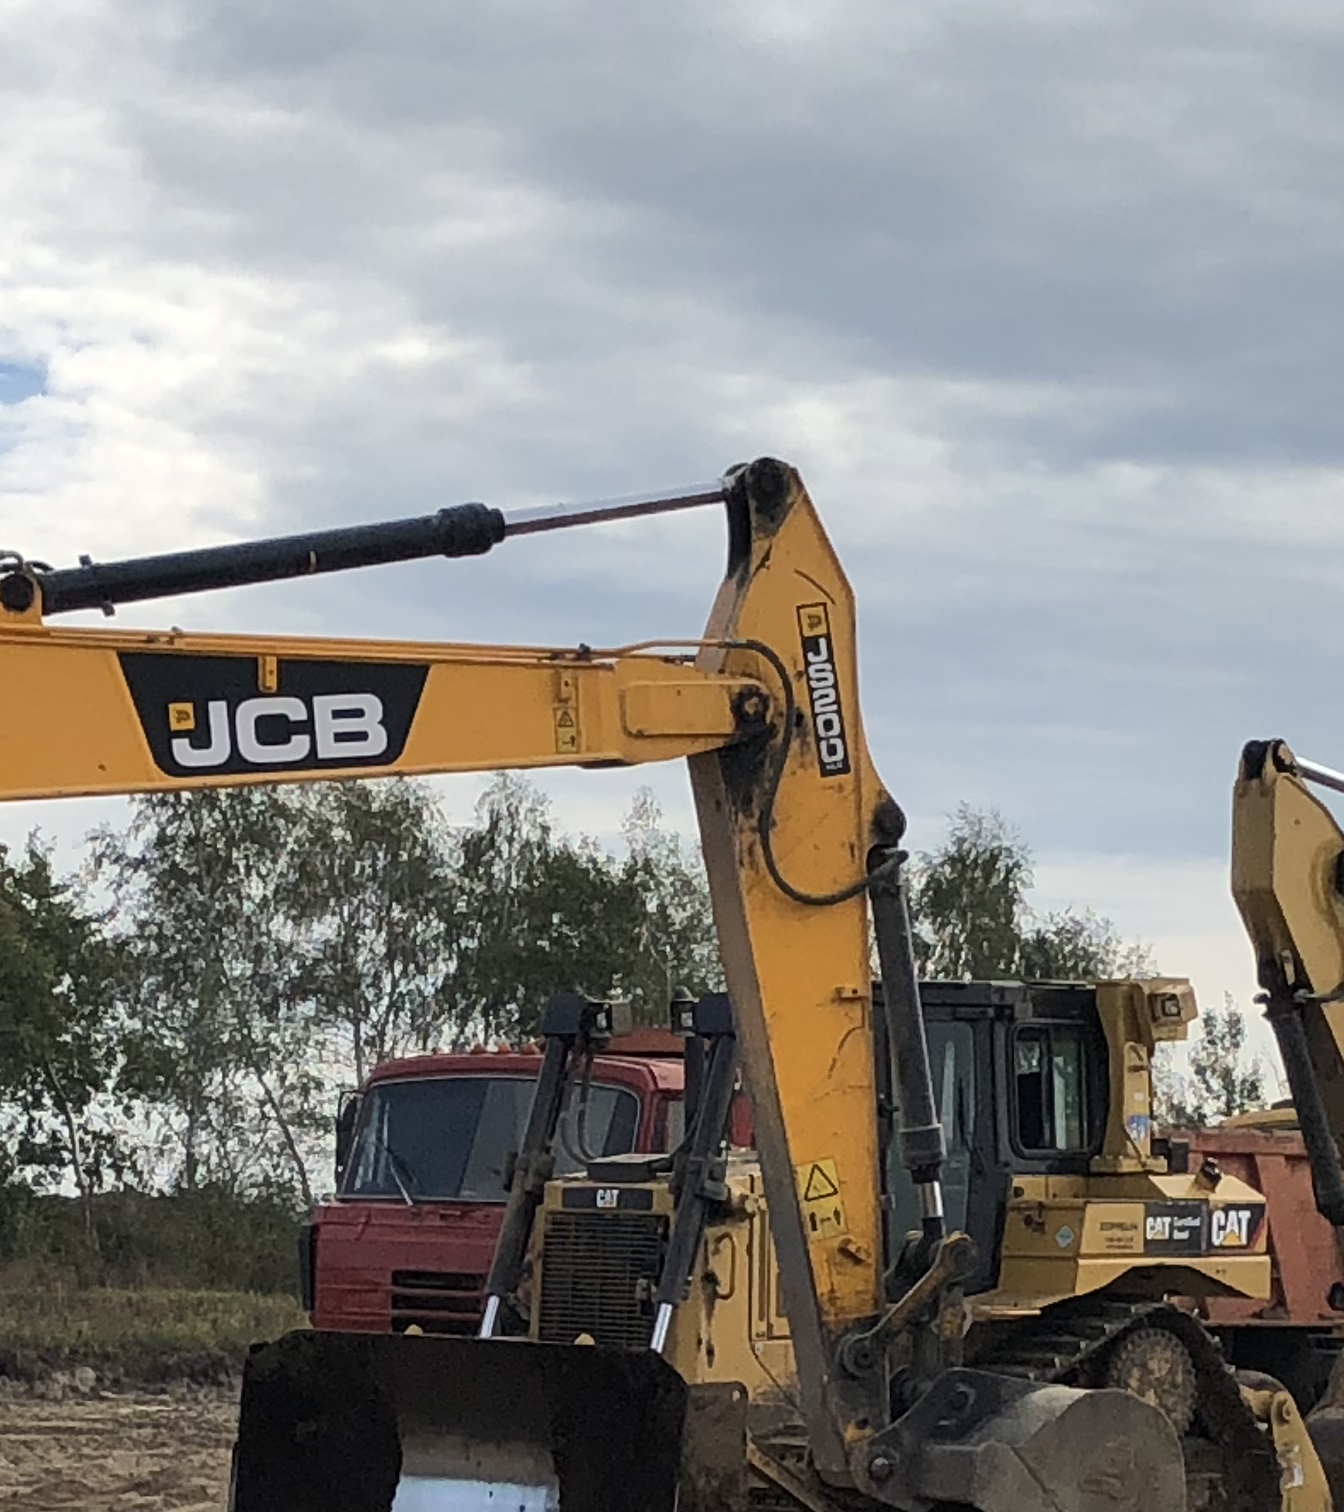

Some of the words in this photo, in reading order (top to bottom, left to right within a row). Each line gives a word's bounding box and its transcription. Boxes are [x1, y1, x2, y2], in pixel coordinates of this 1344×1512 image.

[807, 637, 845, 764] JS200
[170, 693, 389, 768] JCB
[596, 1189, 620, 1208] CAT
[1146, 1216, 1172, 1240] CAT
[1211, 1209, 1252, 1247] CAT
